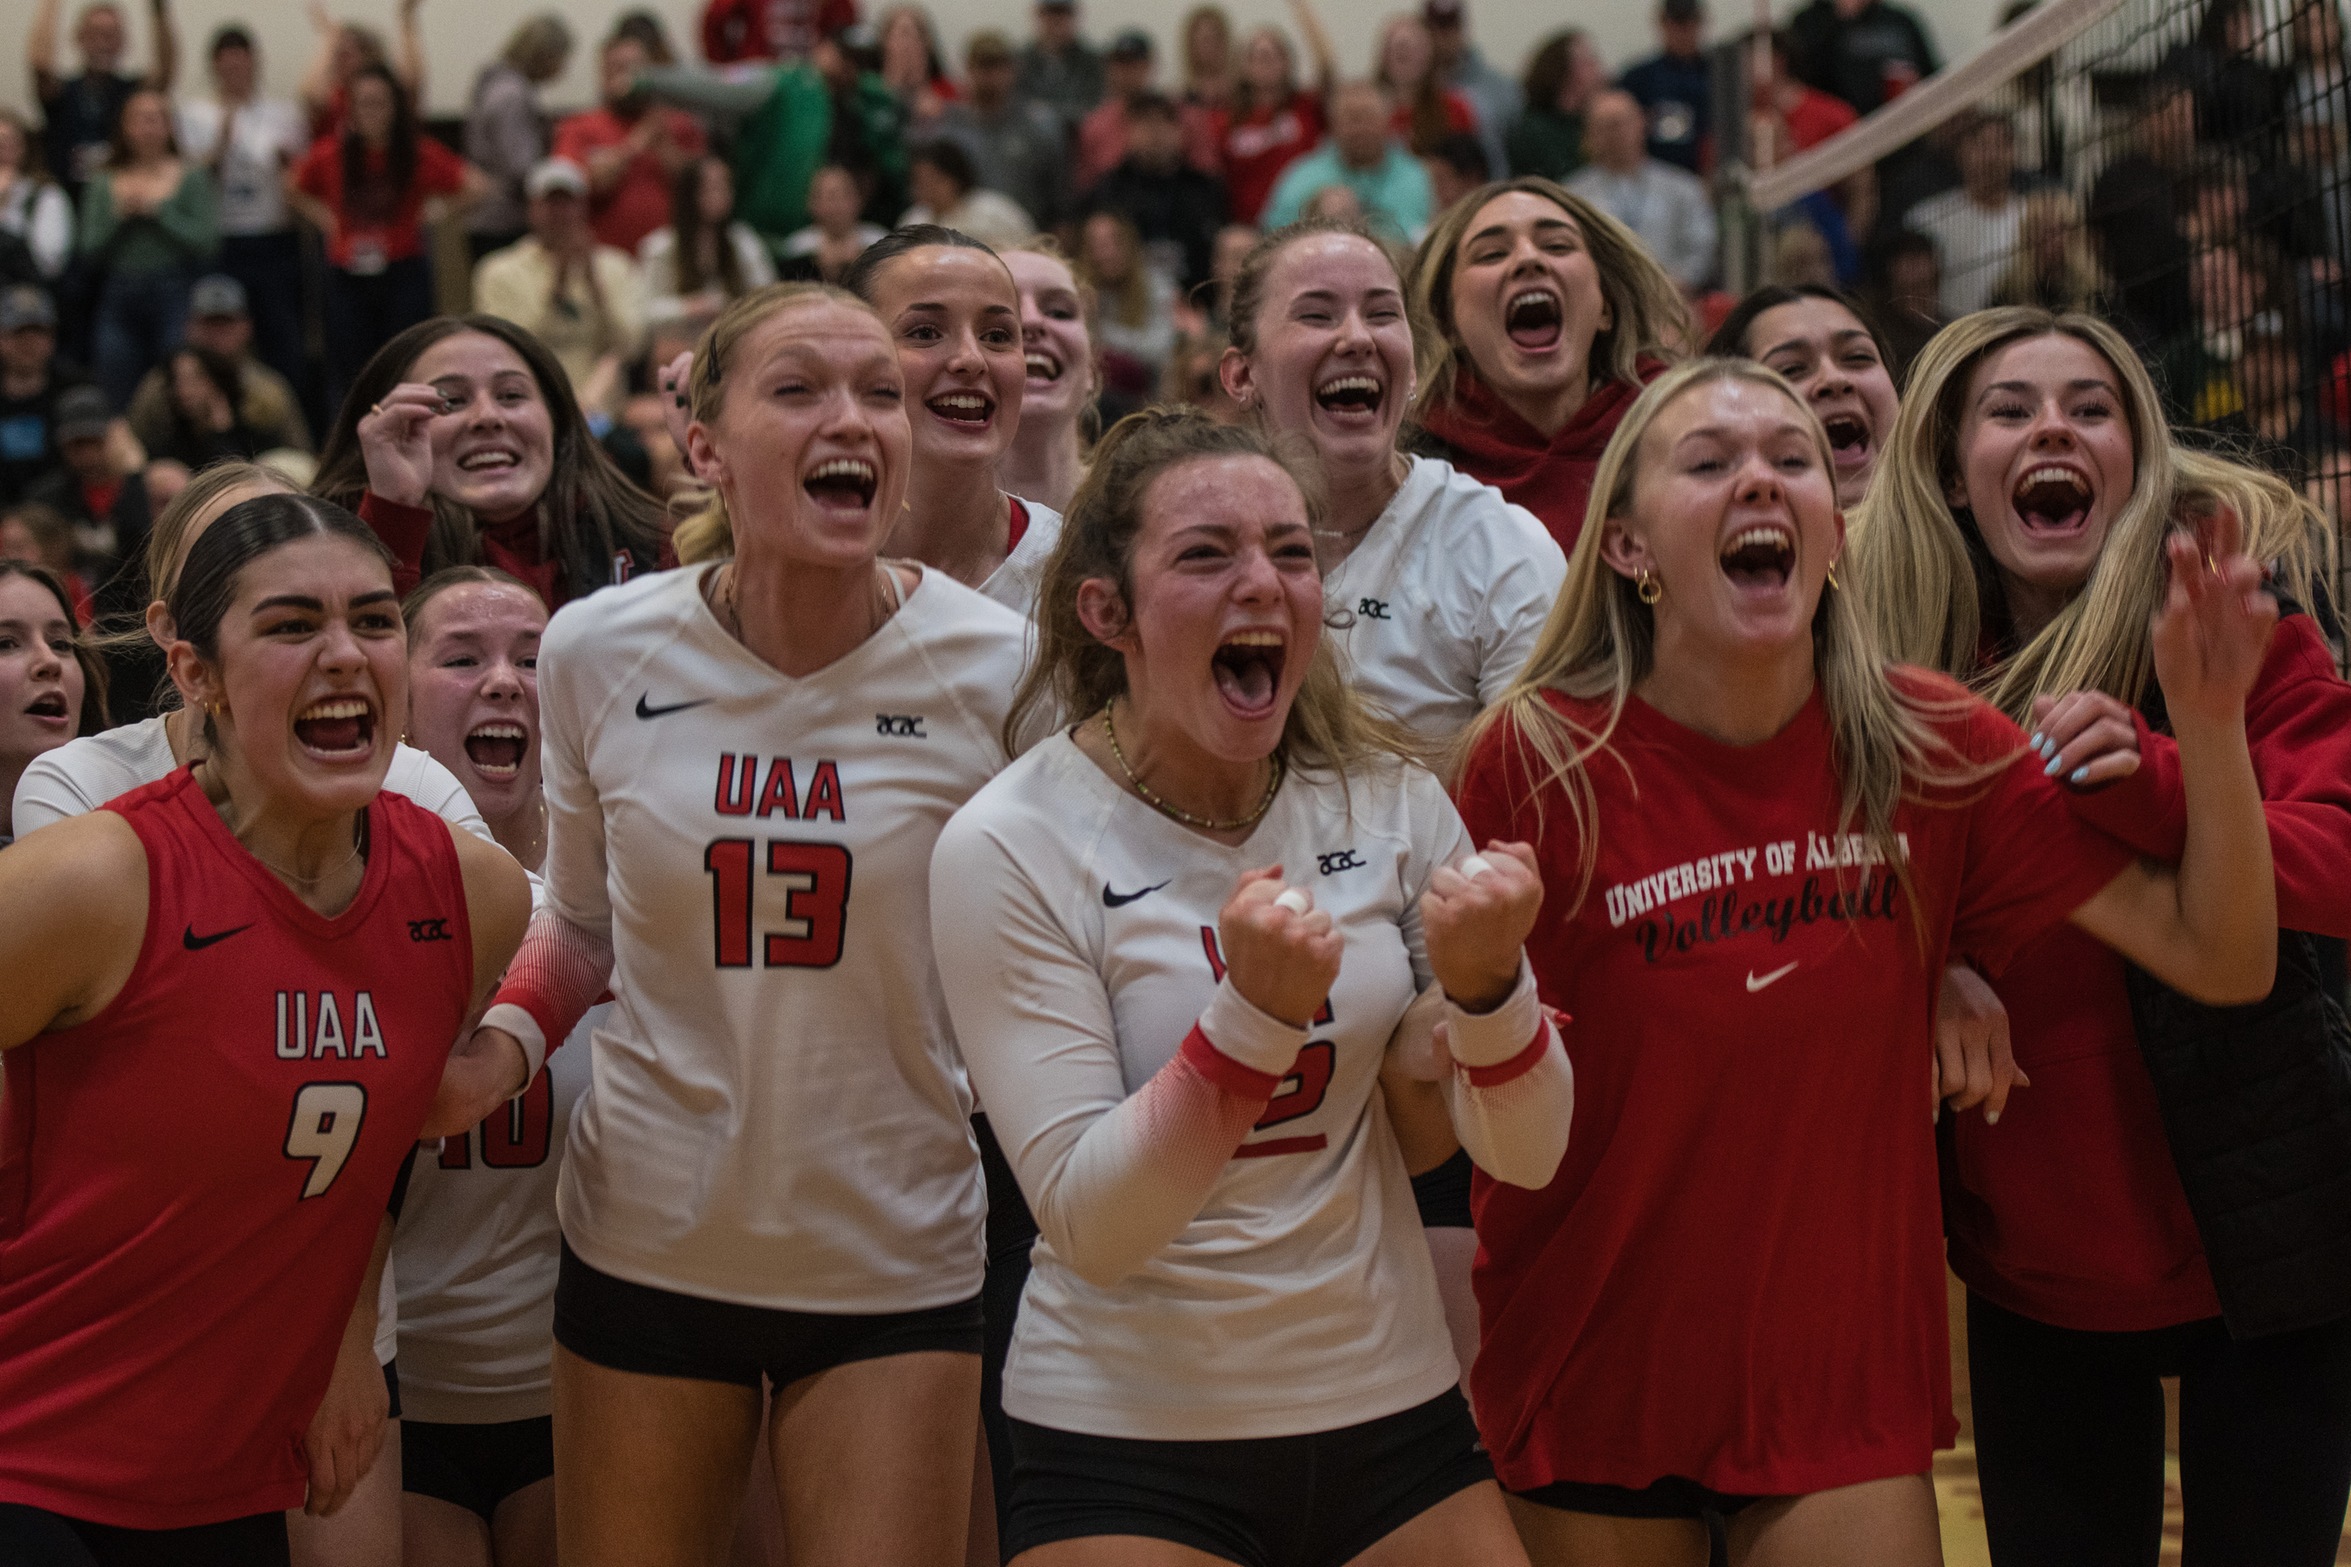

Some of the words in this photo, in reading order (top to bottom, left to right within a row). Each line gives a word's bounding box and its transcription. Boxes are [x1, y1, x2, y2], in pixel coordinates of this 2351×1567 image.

[876, 713, 927, 738] acac
[715, 753, 846, 822] UAA
[1317, 849, 1366, 875] acac
[1605, 846, 1757, 929] UNIVERSITY
[1765, 840, 1796, 877] OF
[1805, 829, 1911, 872] ALBERA
[407, 918, 452, 942] acac
[704, 838, 853, 969] 13
[1635, 872, 1899, 964] Volleyball
[275, 991, 388, 1060] UAA
[282, 1081, 368, 1201] 9
[438, 1064, 554, 1170] 0
